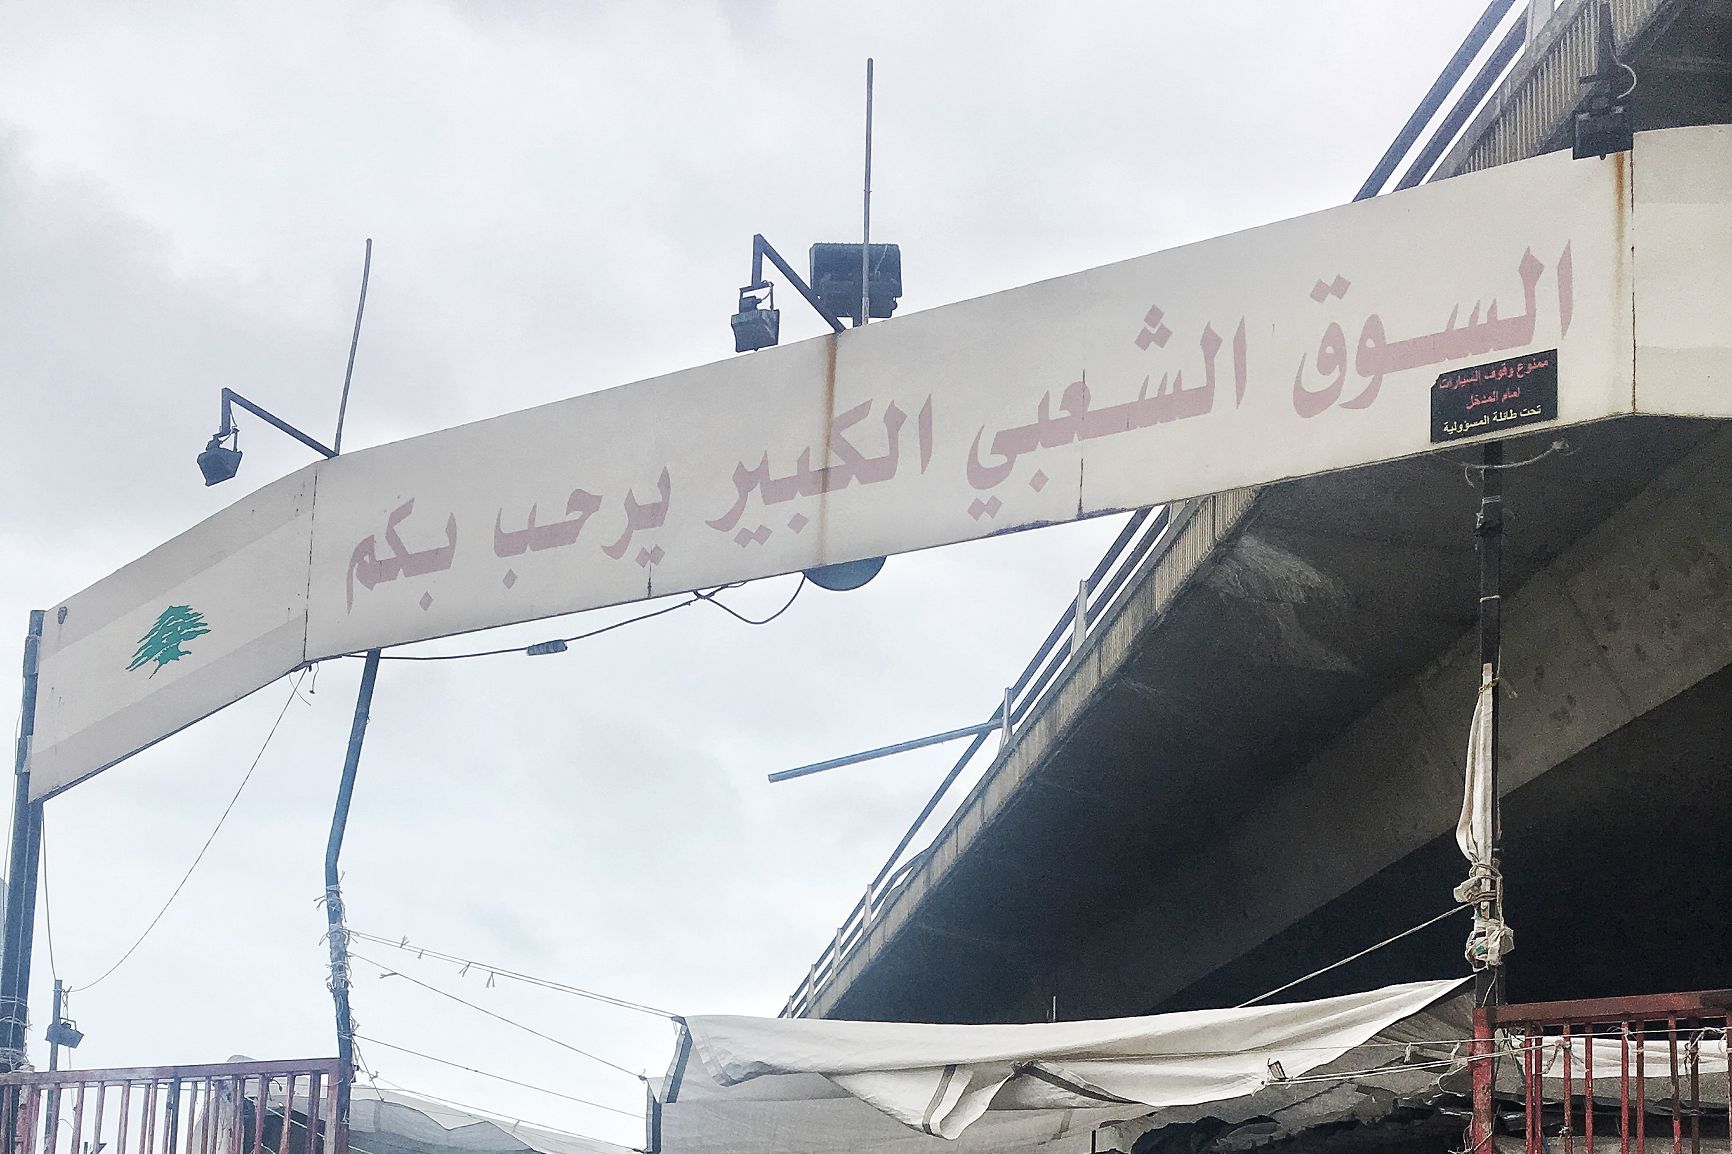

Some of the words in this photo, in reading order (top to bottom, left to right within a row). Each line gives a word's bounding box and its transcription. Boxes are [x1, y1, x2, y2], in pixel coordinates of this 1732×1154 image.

[1293, 239, 1574, 418] السوق
[1484, 362, 1515, 381] وقوف
[1516, 358, 1549, 379] ممنوع
[1439, 369, 1480, 390] السيارات
[1465, 390, 1499, 411] المدخل
[1519, 404, 1542, 417] تحت
[966, 304, 1246, 521] الشعبي
[1443, 414, 1490, 435] المسؤولية
[705, 393, 932, 548] الكبير
[493, 465, 672, 589] يرحب
[346, 497, 457, 615] بكم
